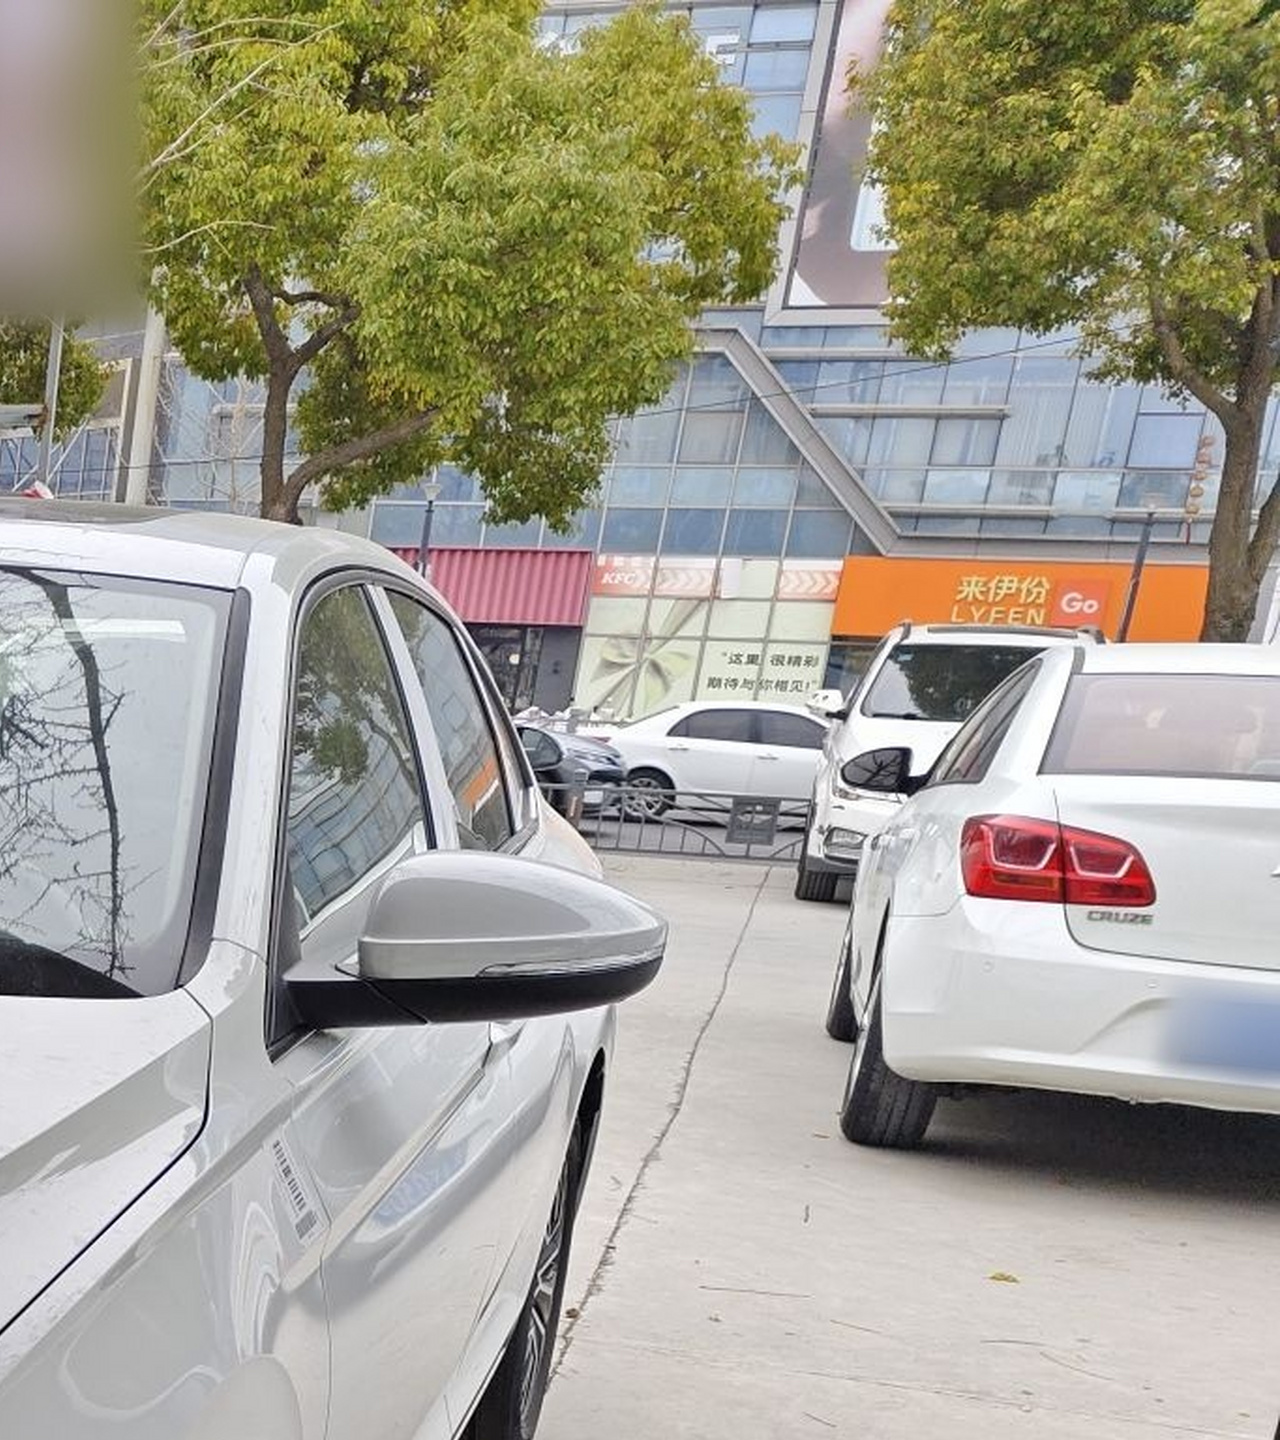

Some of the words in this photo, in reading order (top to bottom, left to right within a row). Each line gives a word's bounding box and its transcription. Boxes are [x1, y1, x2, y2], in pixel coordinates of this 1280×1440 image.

[601, 571, 637, 585] KFC
[956, 574, 1050, 604] 来伊份
[1061, 592, 1100, 614] Go
[951, 605, 1045, 625] LYFEN
[1087, 911, 1153, 925] CRUZE
